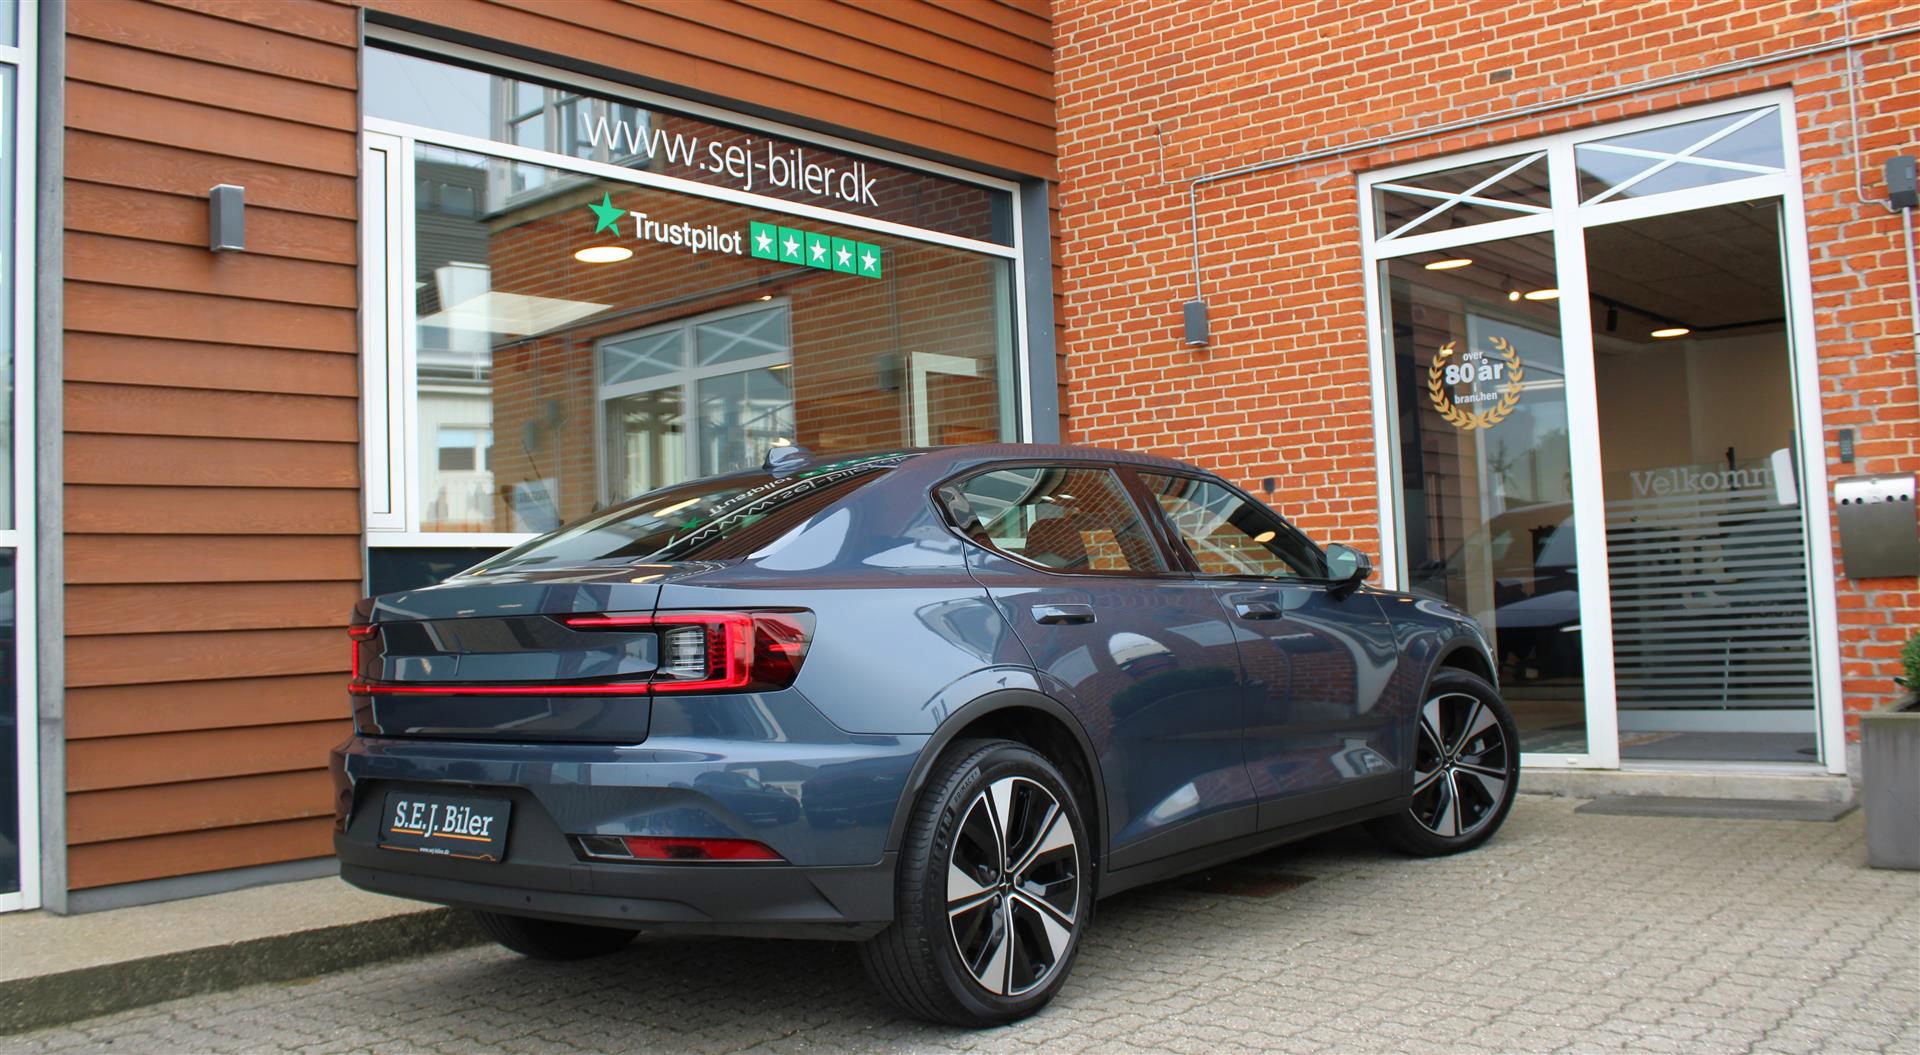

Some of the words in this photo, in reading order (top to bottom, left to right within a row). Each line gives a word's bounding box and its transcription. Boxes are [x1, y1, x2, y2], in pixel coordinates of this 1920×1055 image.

[583, 111, 879, 207] www.sej-biler.dk
[630, 210, 743, 255] Trustpilot
[1445, 362, 1475, 385] 80
[1478, 358, 1504, 382] år
[1463, 351, 1483, 361] over
[1454, 391, 1498, 404] branchen
[1630, 466, 1776, 497] Velkomm
[394, 801, 438, 838] S.E.J.
[442, 805, 493, 837] Biler
